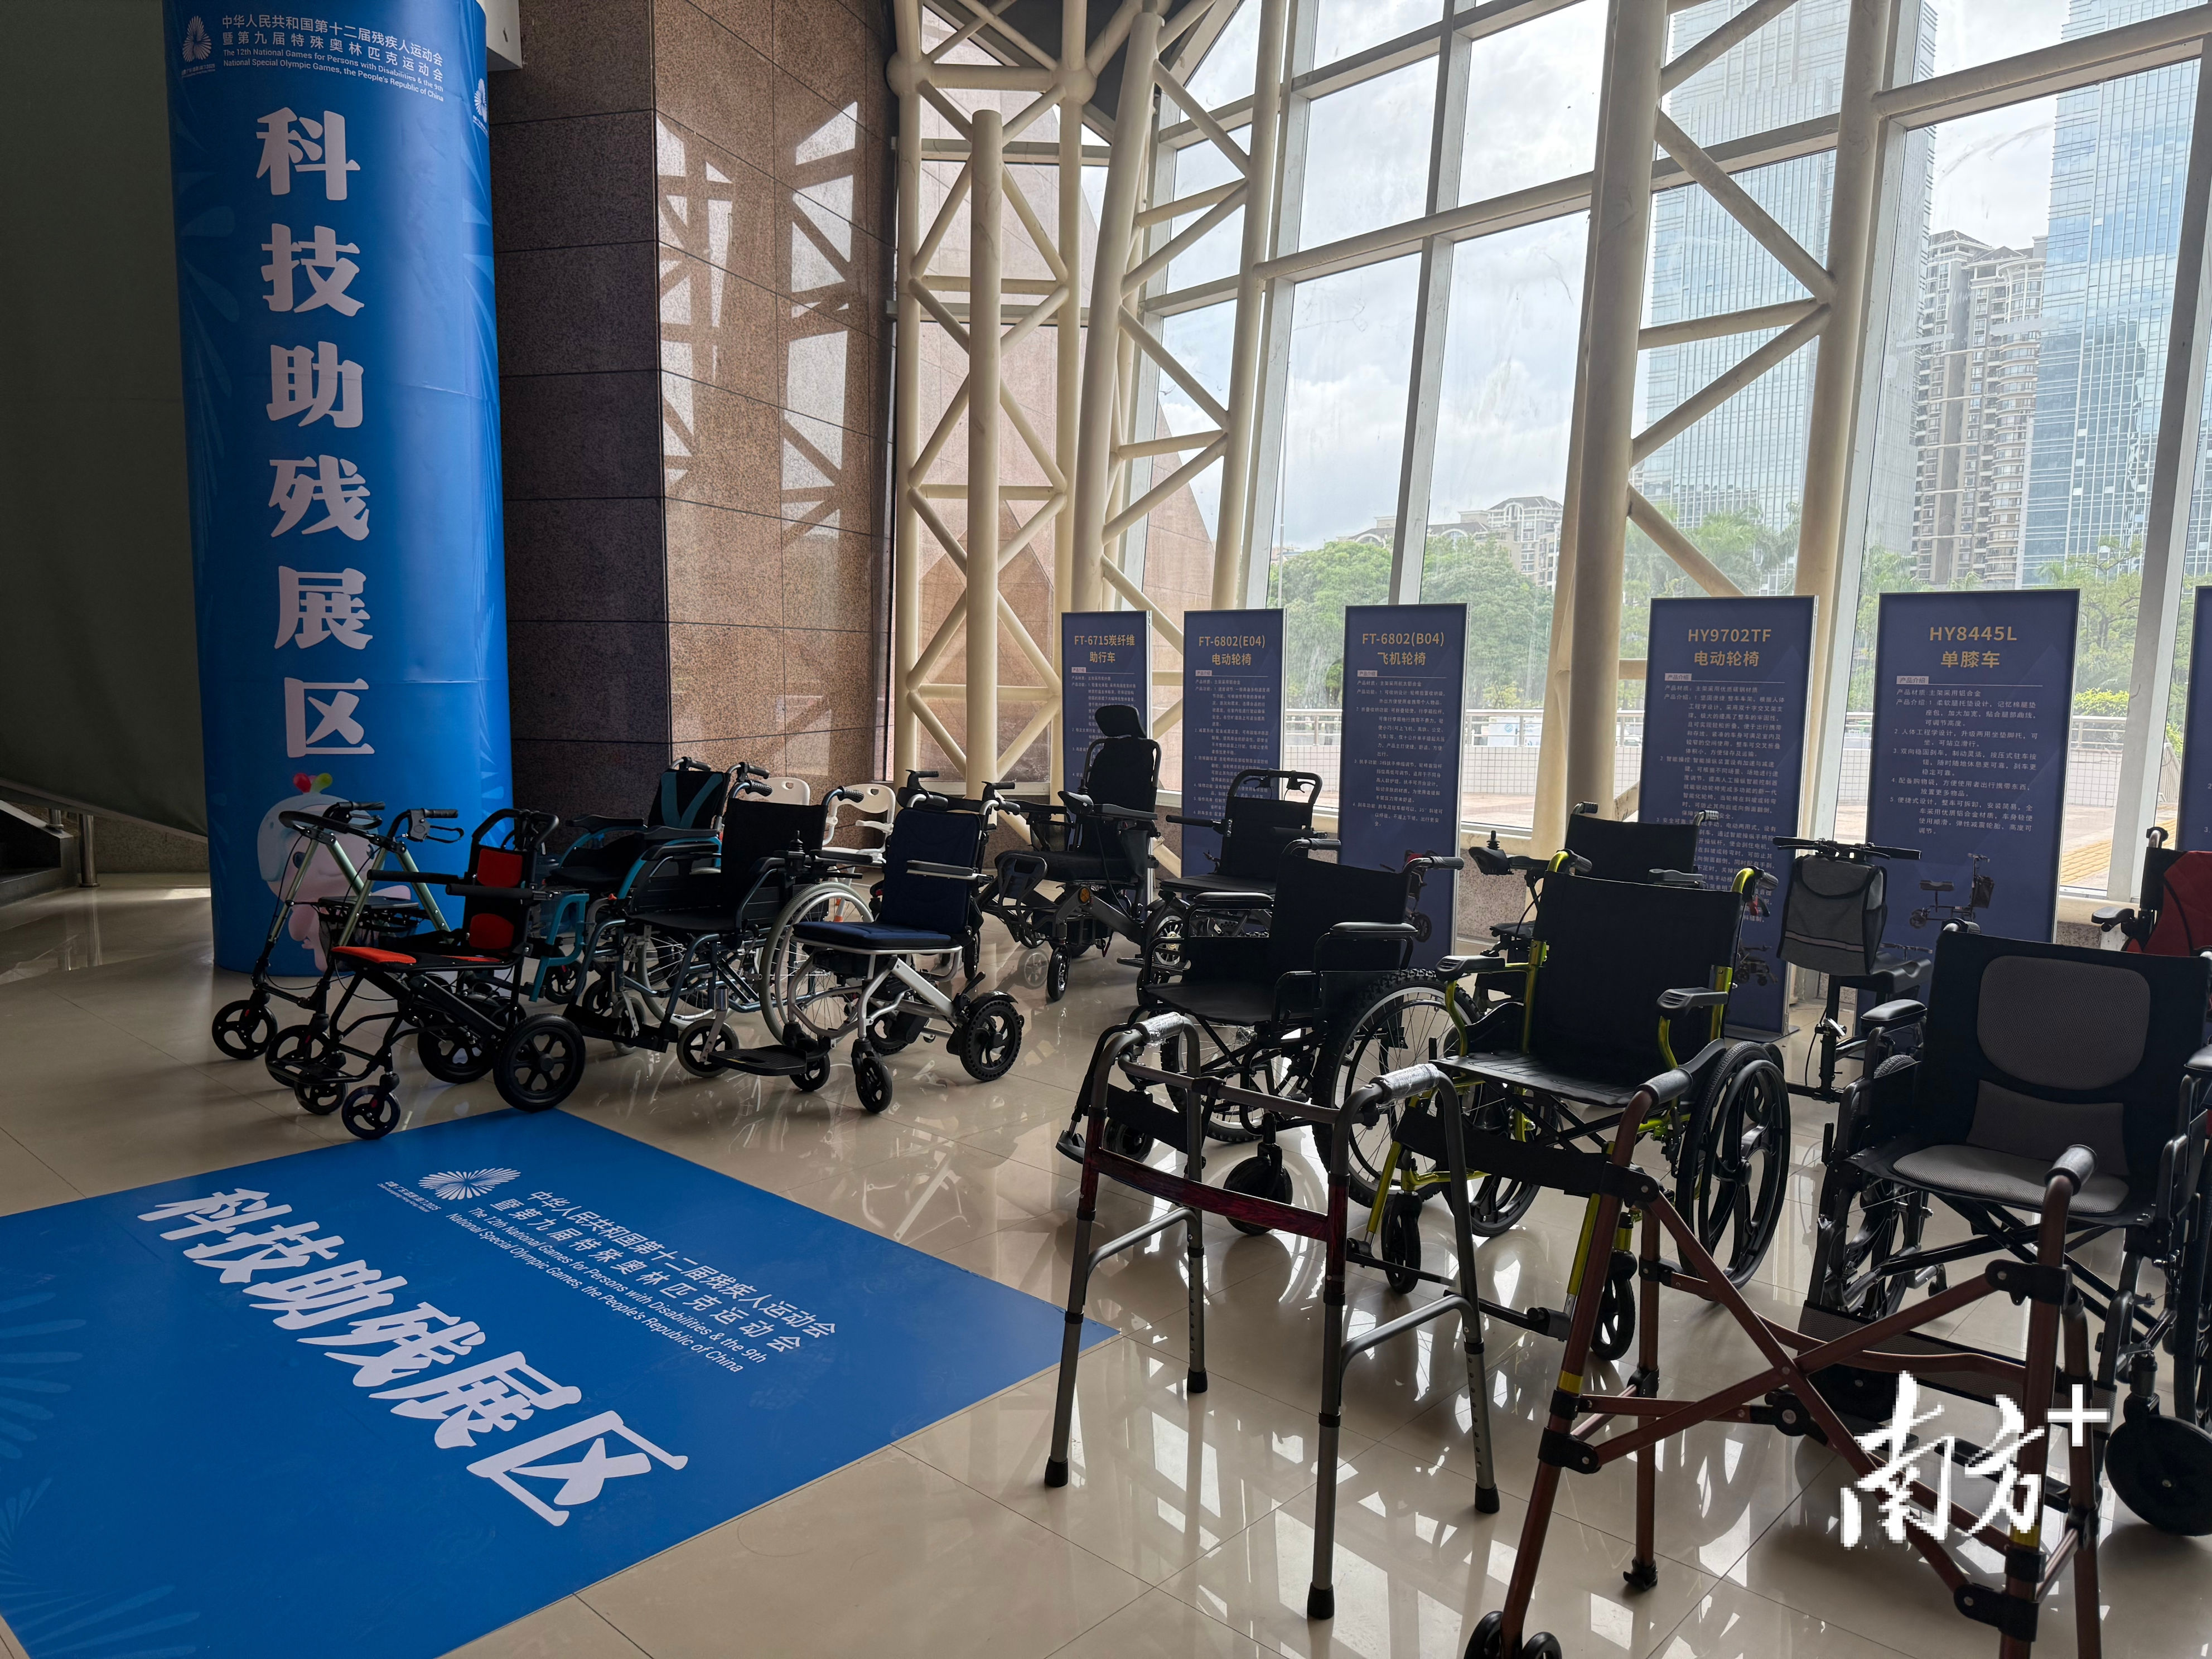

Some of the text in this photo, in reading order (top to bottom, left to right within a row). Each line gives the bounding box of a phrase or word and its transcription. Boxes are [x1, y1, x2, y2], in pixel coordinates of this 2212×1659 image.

[222, 14, 443, 66] 中华人民共和国第十二届残疾人运动会
[222, 31, 443, 83] 暨第九届特殊奥林匹克运动会
[236, 48, 252, 56] 12th
[253, 48, 284, 57] National
[285, 50, 312, 60] Games
[327, 54, 359, 67] Persons
[360, 61, 376, 71] with
[378, 65, 416, 83] Disabilities
[423, 79, 433, 88] the
[434, 83, 443, 93] 9th
[224, 58, 444, 102] National Special Olympic Games, the People's Republic of China
[256, 107, 375, 758] 科技助残展区
[1074, 634, 1136, 647] FT-6715炭纤维
[1199, 634, 1266, 649] FT-6802(E04)
[1362, 631, 1445, 647] FT-6802(B04)
[1688, 628, 1772, 642] HY9702TF
[1929, 626, 2017, 641] HY8445L
[1089, 651, 1116, 663] 助行车
[1211, 653, 1252, 666] 电动轮椅
[1377, 651, 1426, 666] 飞机轮椅
[1694, 650, 1760, 667] 电动轮椅
[1940, 650, 2001, 668] 单膝车
[490, 1197, 801, 1352] 暨第九届特殊奥林匹克运动会
[527, 1191, 837, 1338] 中华人民共和国第十二届残疾人运动会
[446, 1213, 745, 1374] National Special Olympic Games, the People's Republic of China
[468, 1207, 767, 1365] The 12th National Games for Persons with Disabilities & the 9th
[137, 1188, 688, 1527] 科技助残展区
